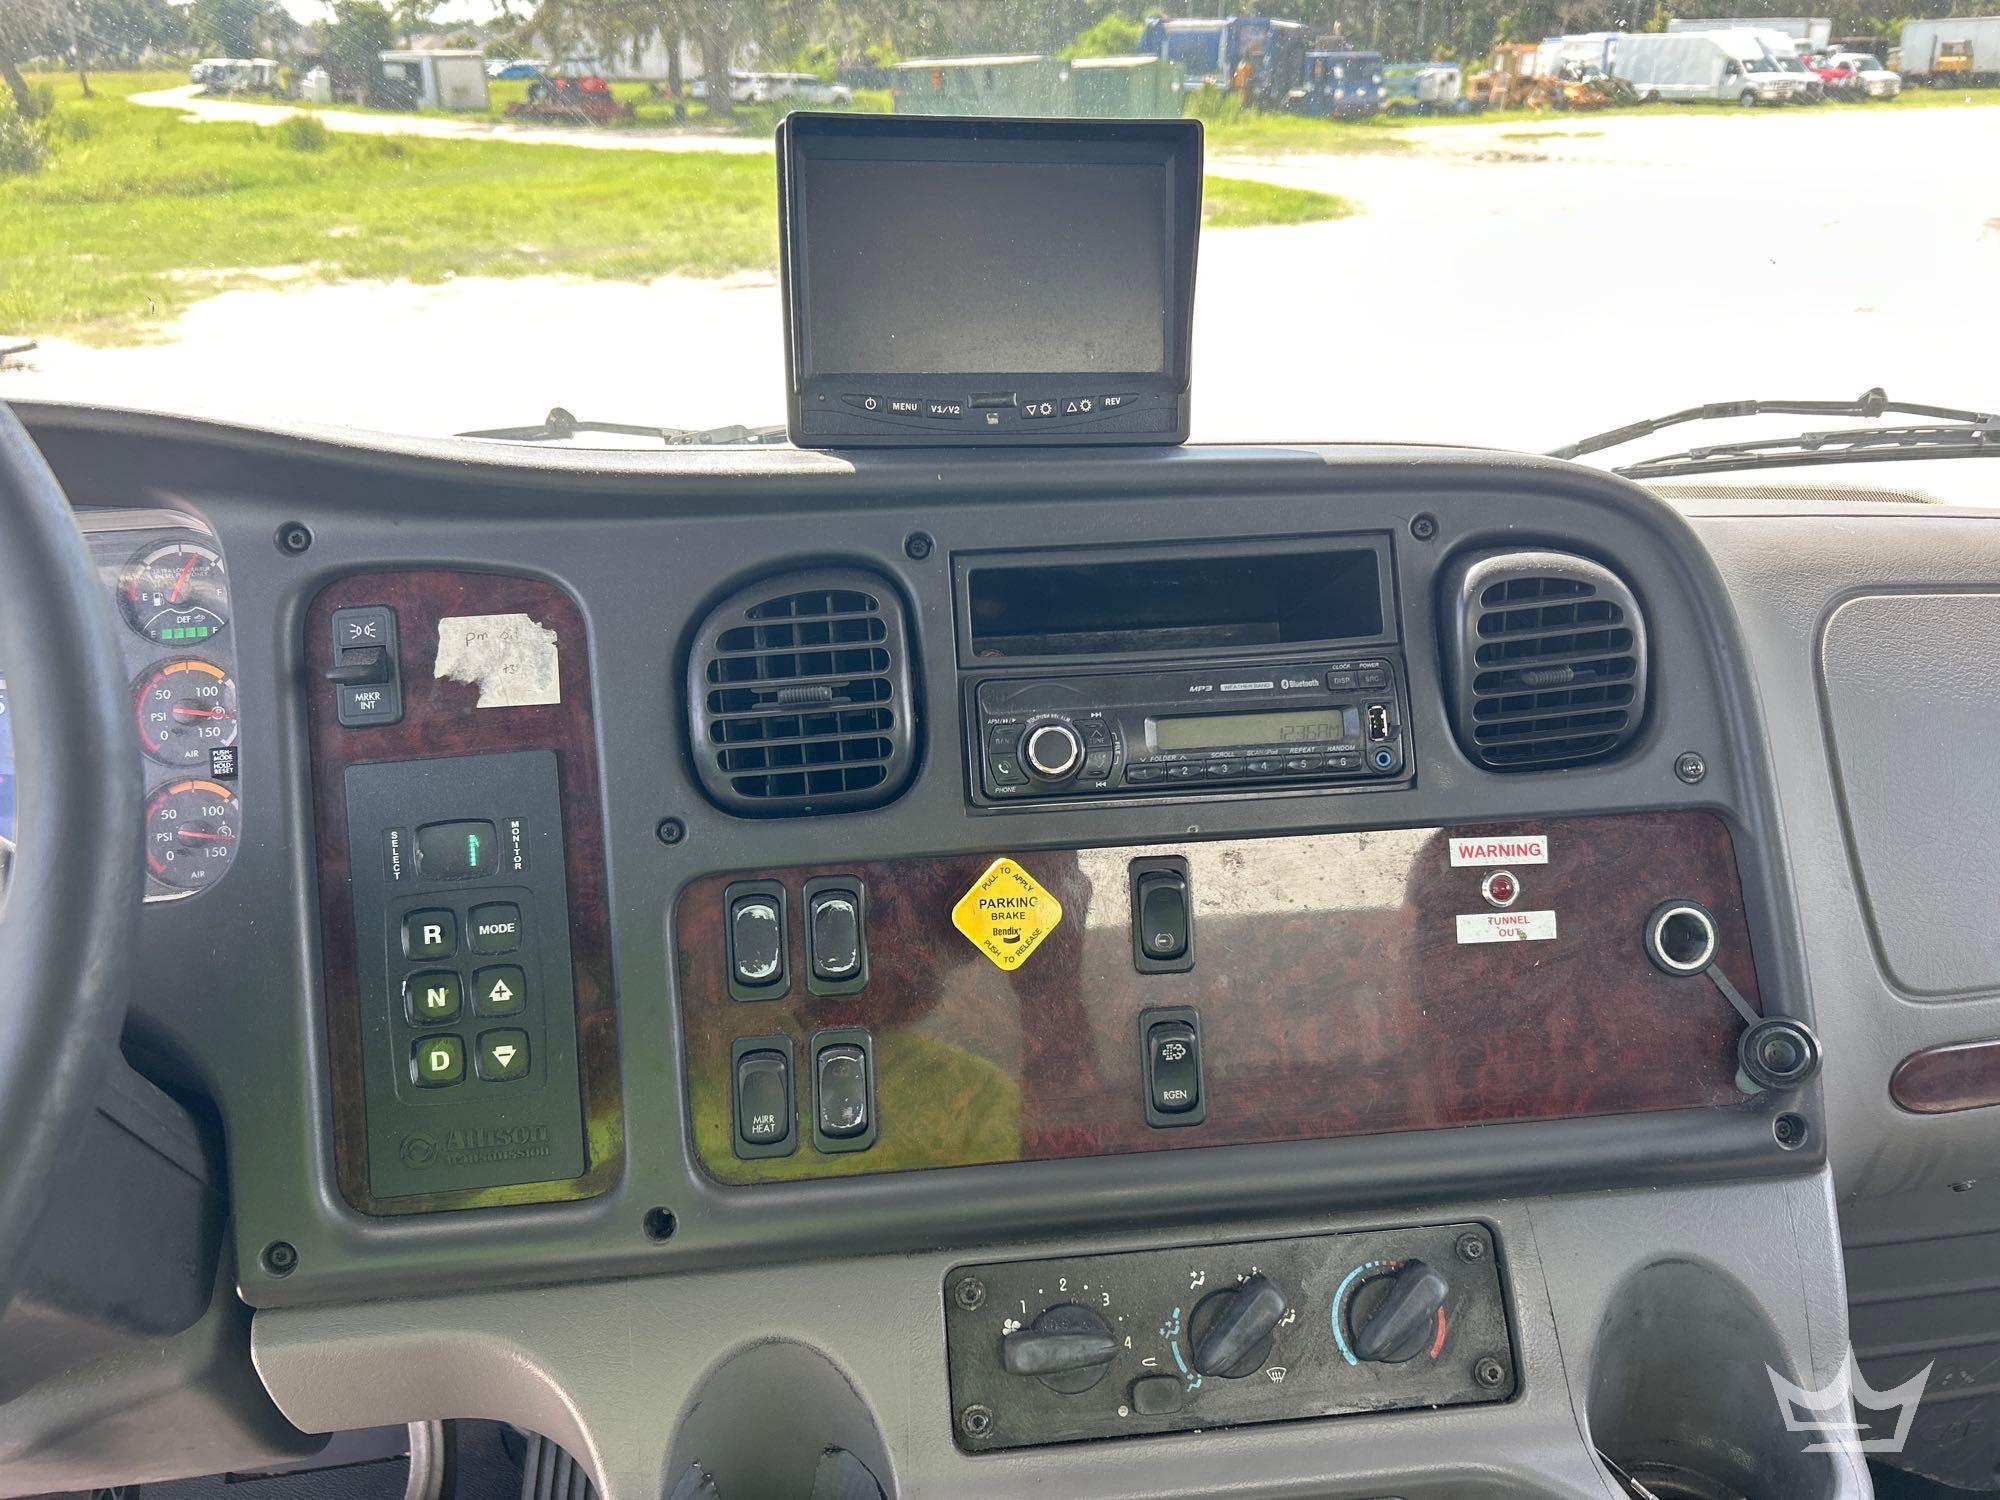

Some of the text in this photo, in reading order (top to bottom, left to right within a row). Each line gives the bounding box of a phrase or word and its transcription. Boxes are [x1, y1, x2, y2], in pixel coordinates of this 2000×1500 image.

[1105, 395, 1121, 406] REV
[892, 401, 917, 412] MENU
[931, 404, 960, 415] V1/V2
[176, 615, 191, 624] DEF
[1289, 679, 1319, 688] Bluetooth
[155, 689, 171, 700] 50
[196, 686, 218, 697] 100
[355, 691, 381, 702] MRKR
[361, 700, 376, 710] INT
[151, 712, 167, 722] PSI
[160, 730, 169, 741] 0
[198, 726, 221, 738] 150
[184, 750, 200, 758] AIR
[1182, 766, 1189, 775] 2
[1221, 764, 1228, 773] 3
[161, 809, 177, 820] 50
[202, 805, 224, 816] 100
[157, 832, 173, 842] PSI
[511, 820, 522, 870] MONITOR
[166, 850, 175, 861] 0
[205, 846, 227, 858] 150
[391, 831, 401, 880] SELECT
[1459, 843, 1541, 859] WARNING
[191, 870, 206, 879] AIR
[981, 874, 999, 891] PULL
[1013, 873, 1035, 892] APPLY
[991, 911, 1026, 921] BRAKE
[1488, 915, 1530, 925] TUNNEL
[423, 924, 442, 945] R
[479, 923, 516, 935] MODE
[993, 926, 1019, 936] Bendix
[1498, 928, 1521, 937] OUT
[983, 939, 1001, 957] PUSH
[1015, 928, 1043, 957] RELEASE
[427, 987, 446, 1008] N
[431, 1051, 450, 1071] D
[1163, 1089, 1187, 1100] RGEN
[753, 1114, 775, 1124] MIRR
[752, 1123, 776, 1134] HEAT
[1060, 1278, 1067, 1292] 2
[1102, 1292, 1110, 1306] 3
[1020, 1300, 1026, 1313] 1
[1124, 1336, 1132, 1349] 4
